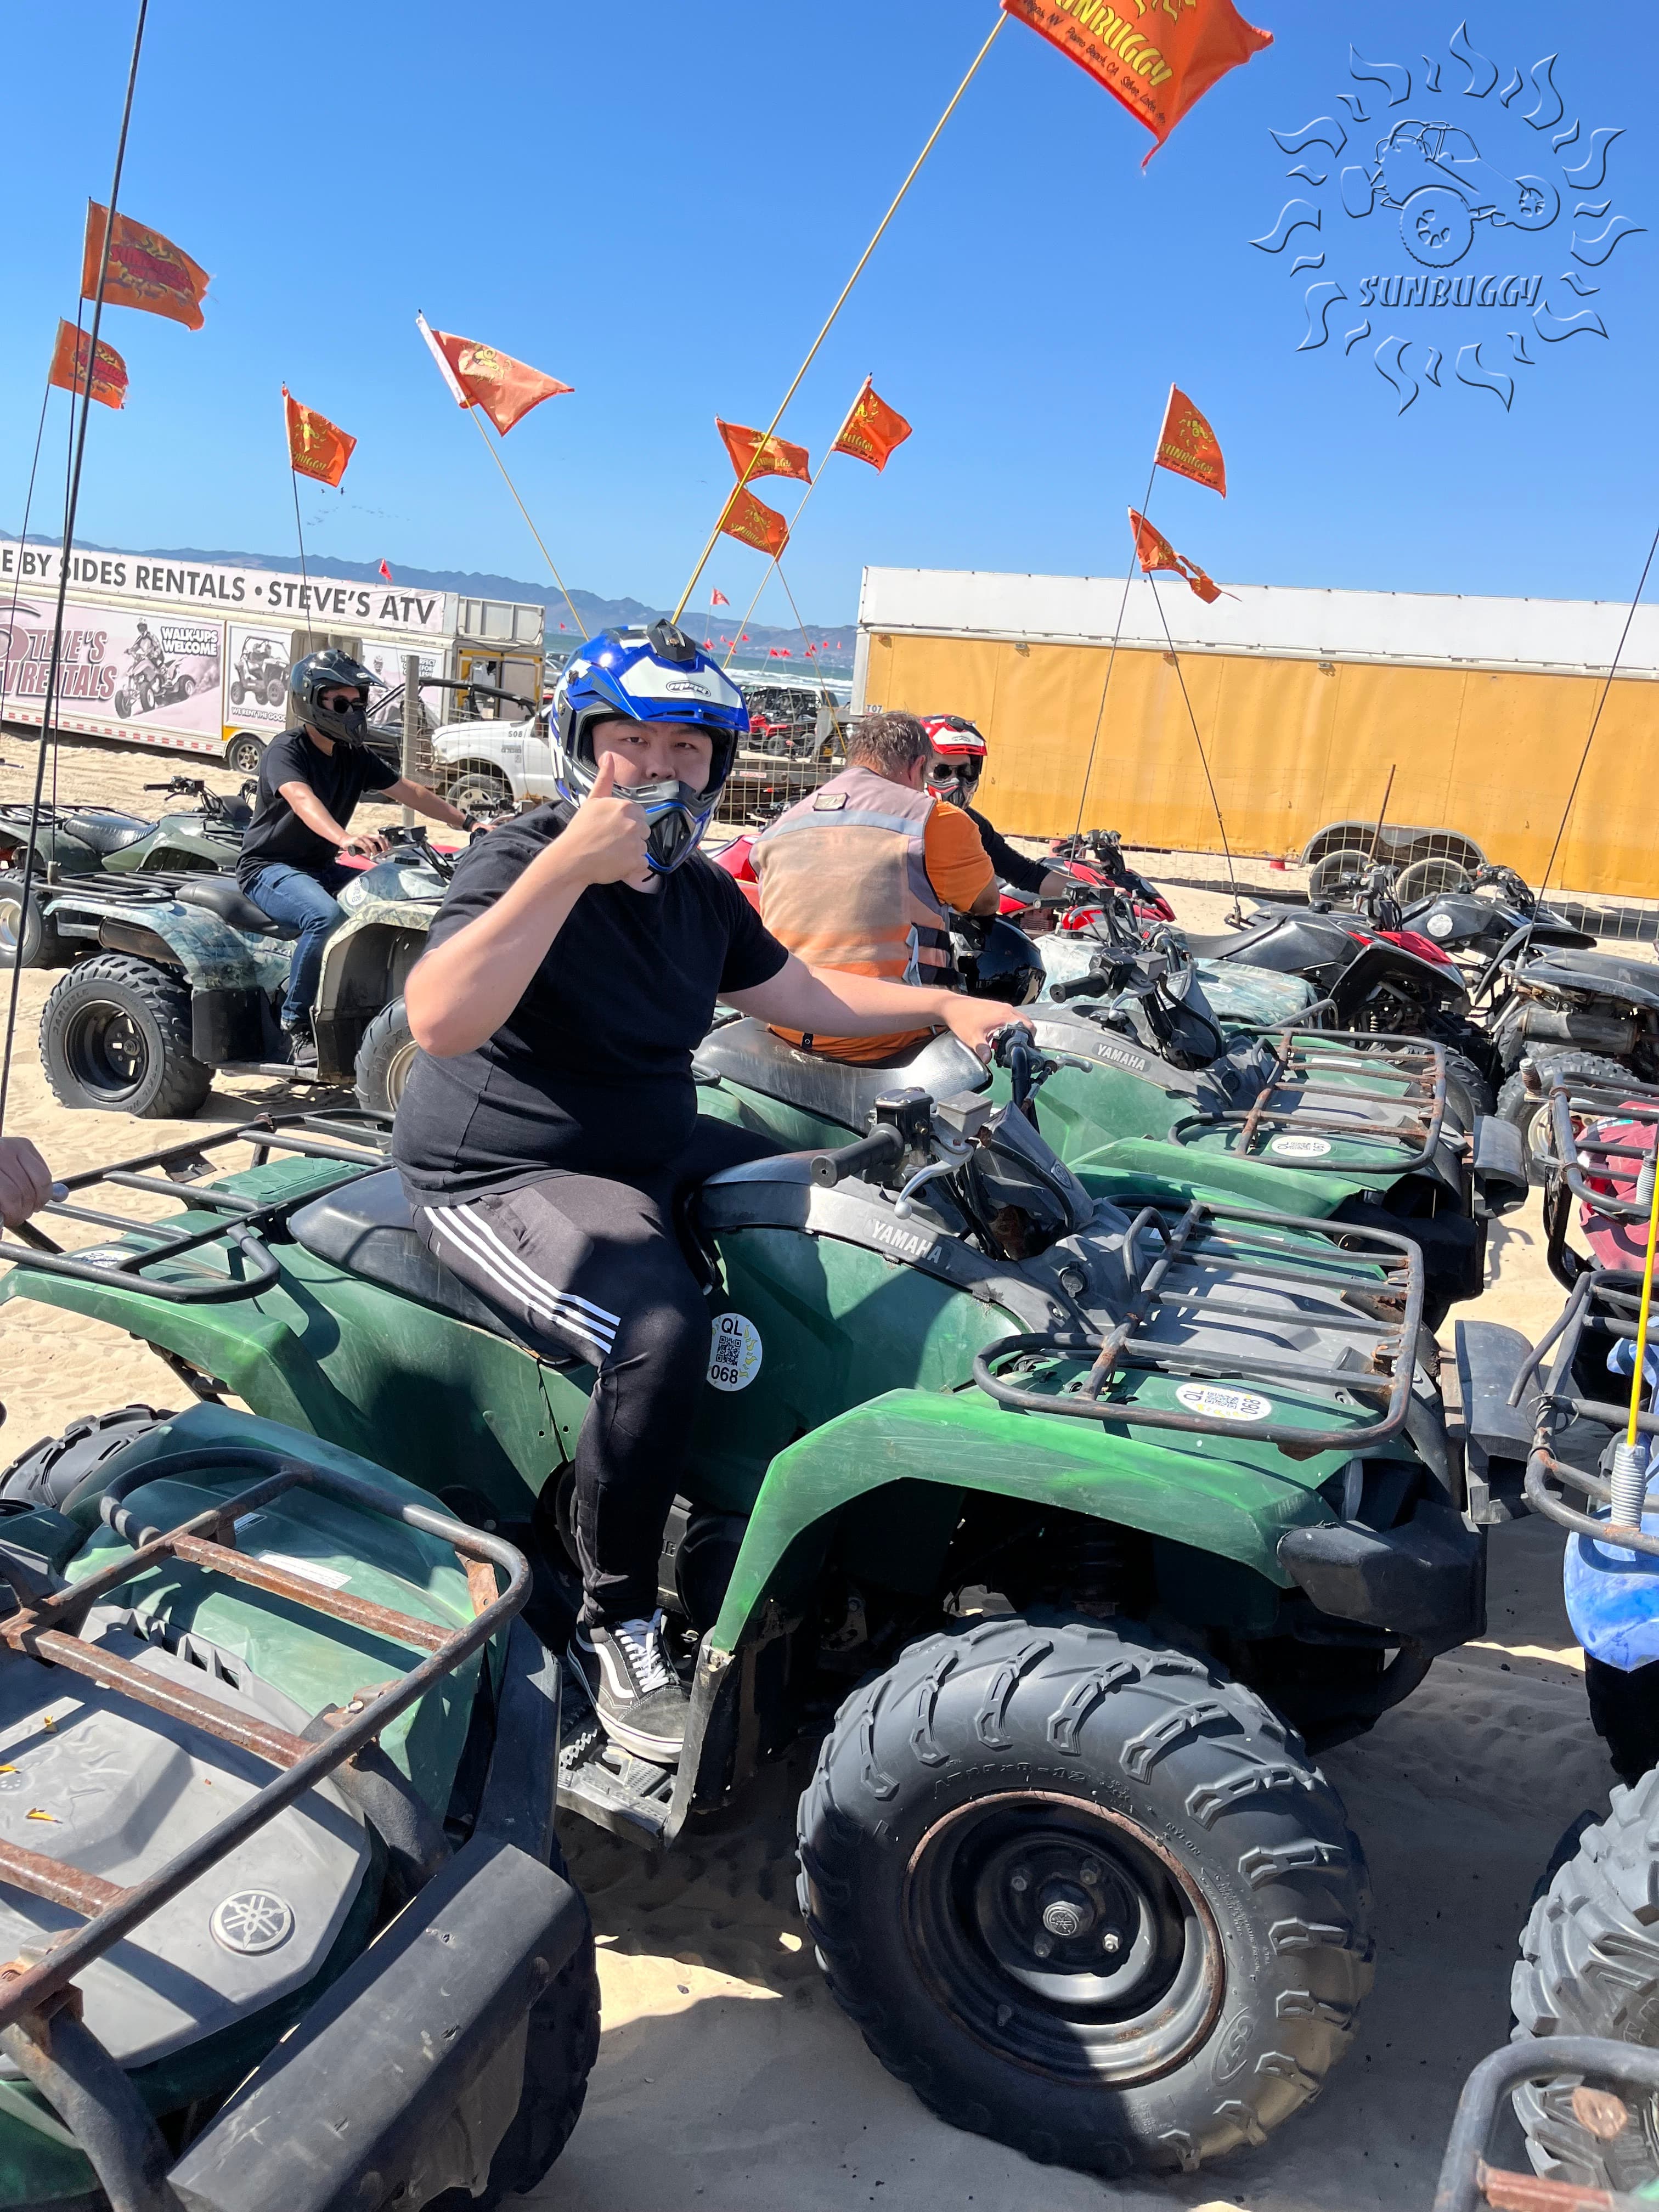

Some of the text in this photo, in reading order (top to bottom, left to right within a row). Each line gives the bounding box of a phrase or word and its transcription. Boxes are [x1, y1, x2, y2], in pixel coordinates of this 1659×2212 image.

[22, 551, 53, 577] BY
[59, 557, 127, 586] SIDES
[136, 565, 246, 602] RENTALS
[267, 580, 371, 617] STEVE'S
[379, 595, 437, 624] ATV
[161, 626, 219, 644] WALK-UPS
[162, 639, 218, 657] WELCOME
[231, 707, 242, 715] WE
[241, 708, 256, 718] RENT
[256, 710, 268, 719] THE
[1097, 1044, 1146, 1071] YAMAHA
[872, 1220, 943, 1264] YAMAHA
[721, 1318, 742, 1336] QL
[711, 1364, 738, 1384] 068
[1183, 1390, 1204, 1401] QL
[1240, 1398, 1261, 1415] 068
[1166, 1822, 1201, 1857] NYLON
